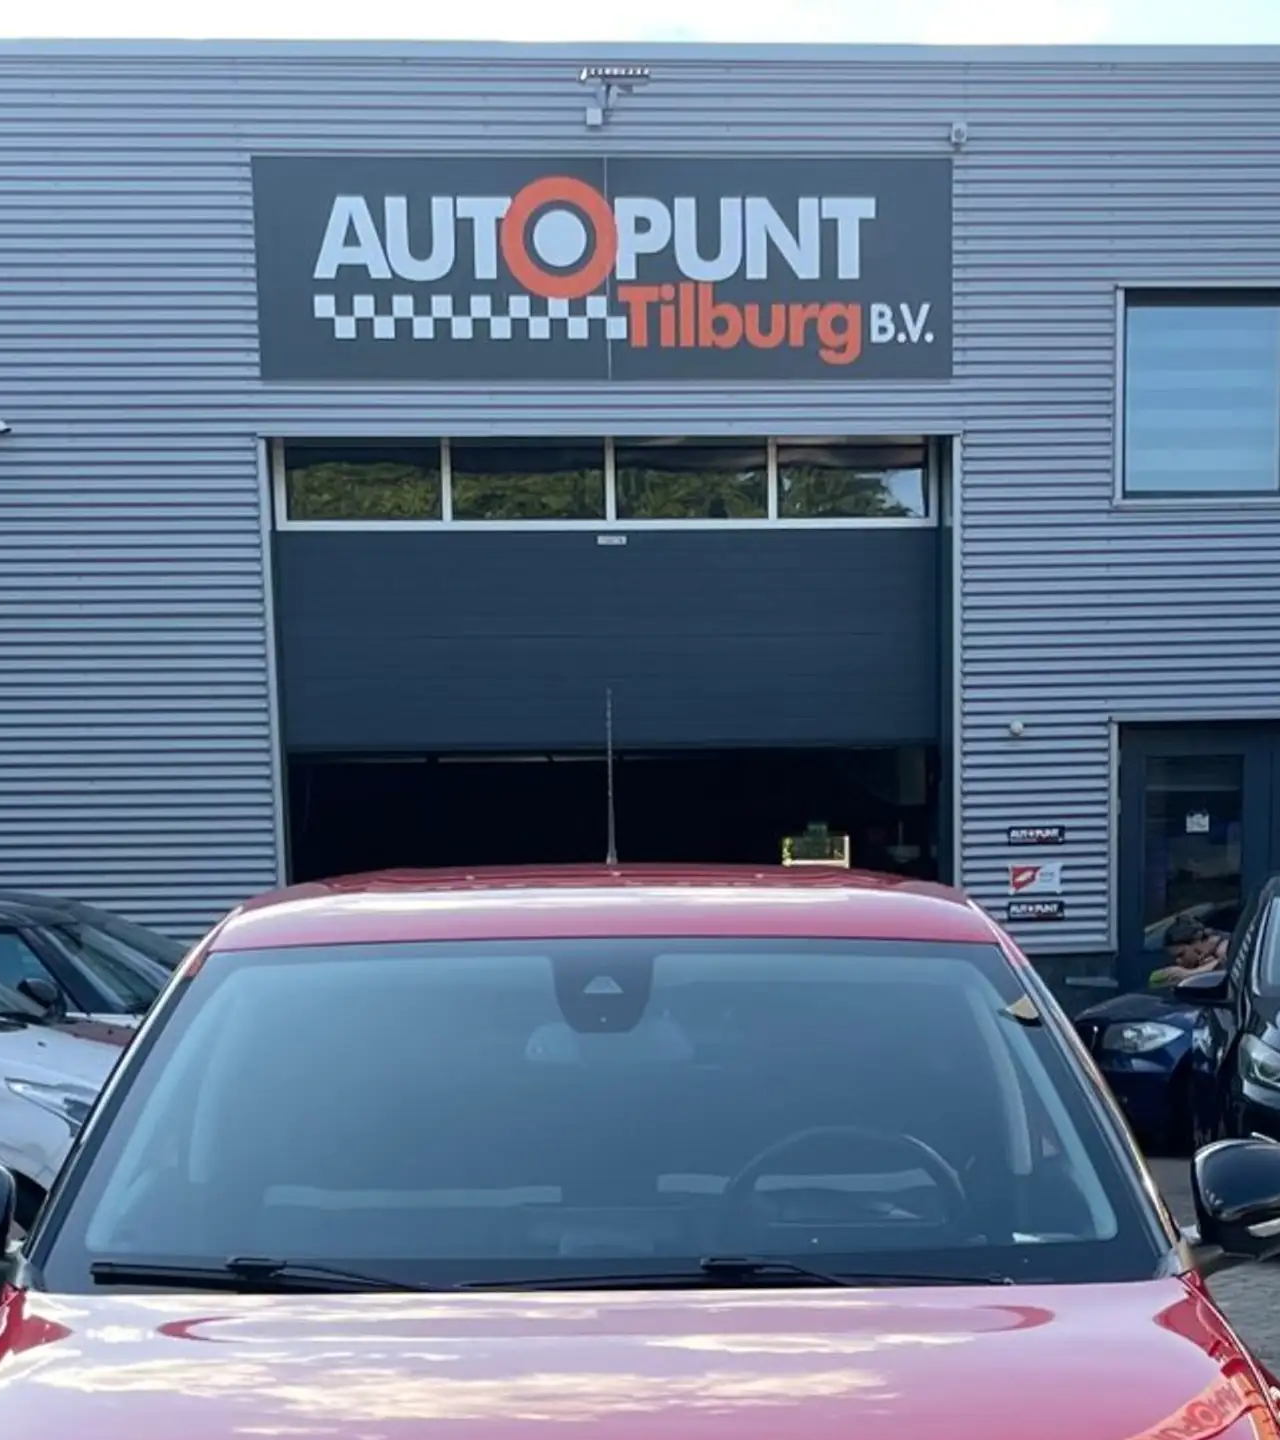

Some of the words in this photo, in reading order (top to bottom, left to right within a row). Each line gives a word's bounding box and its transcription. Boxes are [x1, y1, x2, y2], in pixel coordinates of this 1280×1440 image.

[314, 176, 876, 299] AUTOPUNT
[618, 282, 863, 364] Tilburg
[870, 302, 935, 345] B.V.
